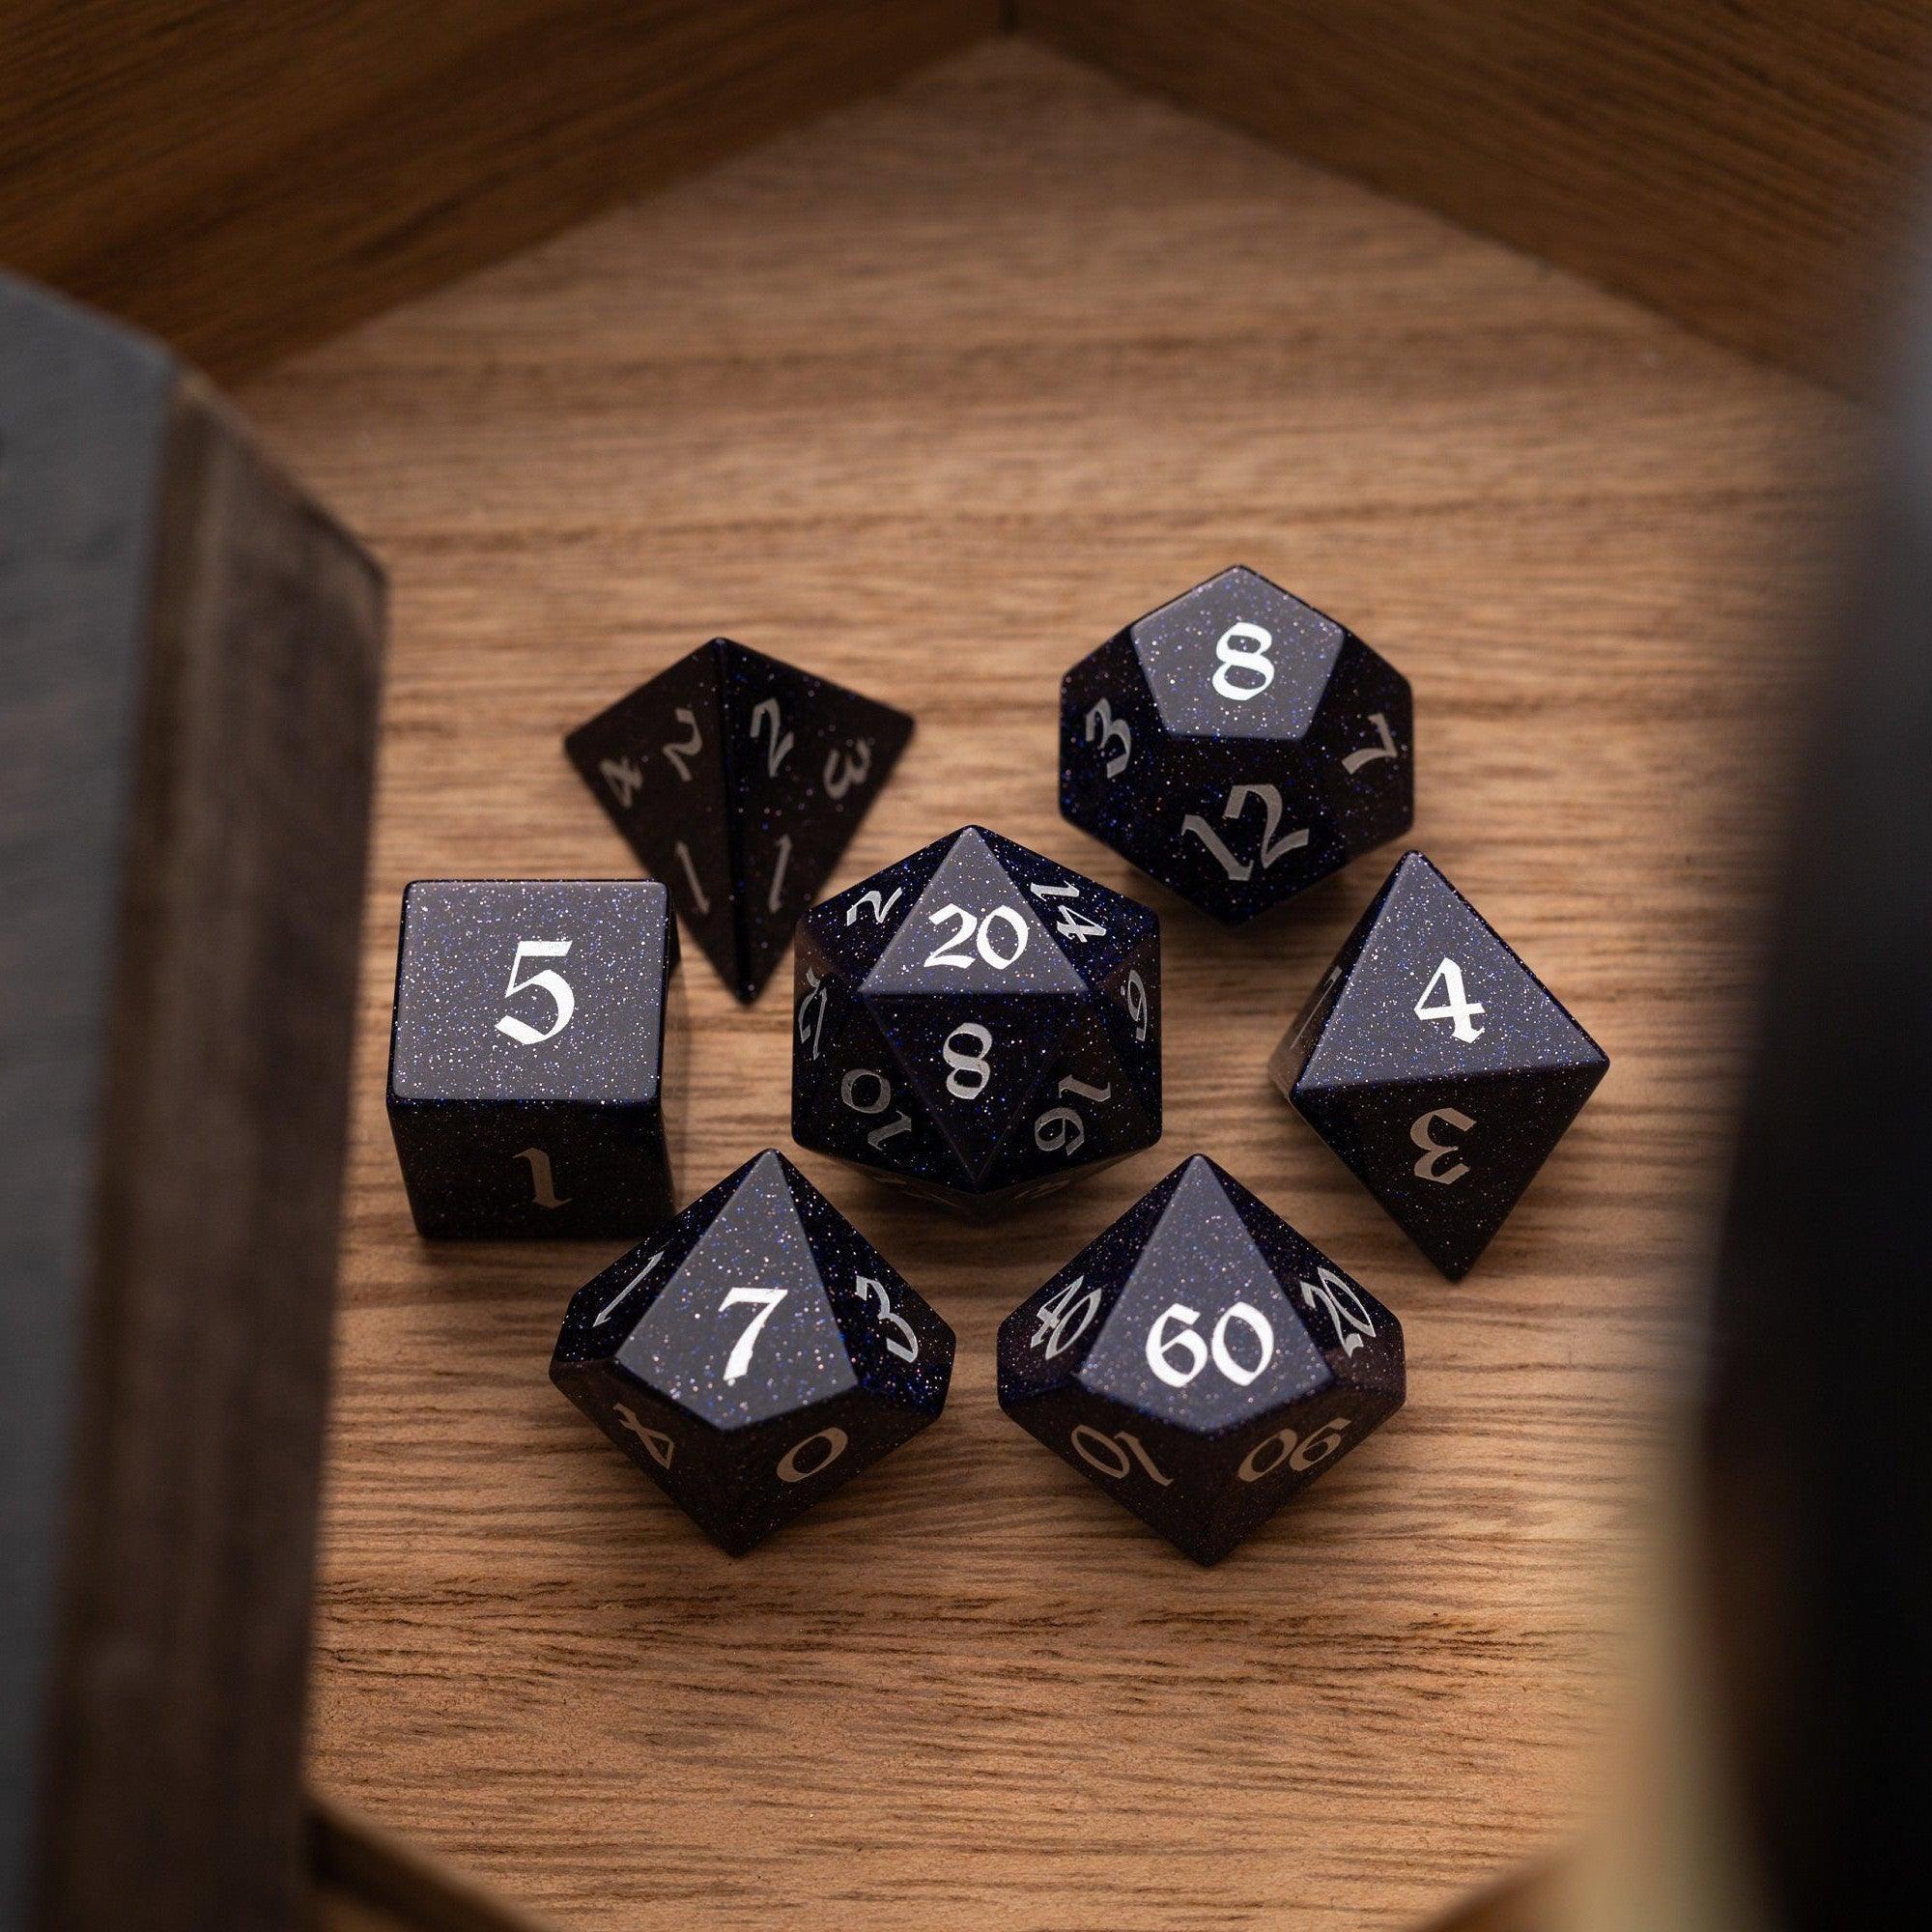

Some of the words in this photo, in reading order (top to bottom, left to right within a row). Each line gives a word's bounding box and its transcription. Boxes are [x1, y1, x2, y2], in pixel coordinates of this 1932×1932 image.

[1211, 621, 1275, 701] 8
[663, 707, 703, 782] 2
[750, 696, 795, 779] 2
[823, 737, 871, 801] 3
[1085, 696, 1132, 779] 3
[1341, 712, 1398, 775] 7
[599, 754, 642, 810] 4
[1180, 783, 1310, 882] 12
[676, 841, 710, 915] 1
[769, 834, 793, 915] 1
[846, 886, 903, 926] 2
[1030, 879, 1107, 944] 14
[923, 902, 1029, 970] 20
[494, 939, 576, 1046] 5
[1413, 956, 1486, 1044] 4
[943, 1021, 993, 1100] 8
[840, 1067, 913, 1152] 10
[1034, 1073, 1112, 1156] 16
[1409, 1107, 1477, 1185] 3
[512, 1146, 574, 1209] 1
[592, 1250, 666, 1328] 1
[855, 1275, 920, 1364] 3
[1030, 1274, 1103, 1361] 40
[1300, 1266, 1377, 1359] 20
[718, 1286, 789, 1382] 7
[1144, 1300, 1275, 1389] 60
[776, 1426, 850, 1484] 0
[1070, 1423, 1175, 1488] 10
